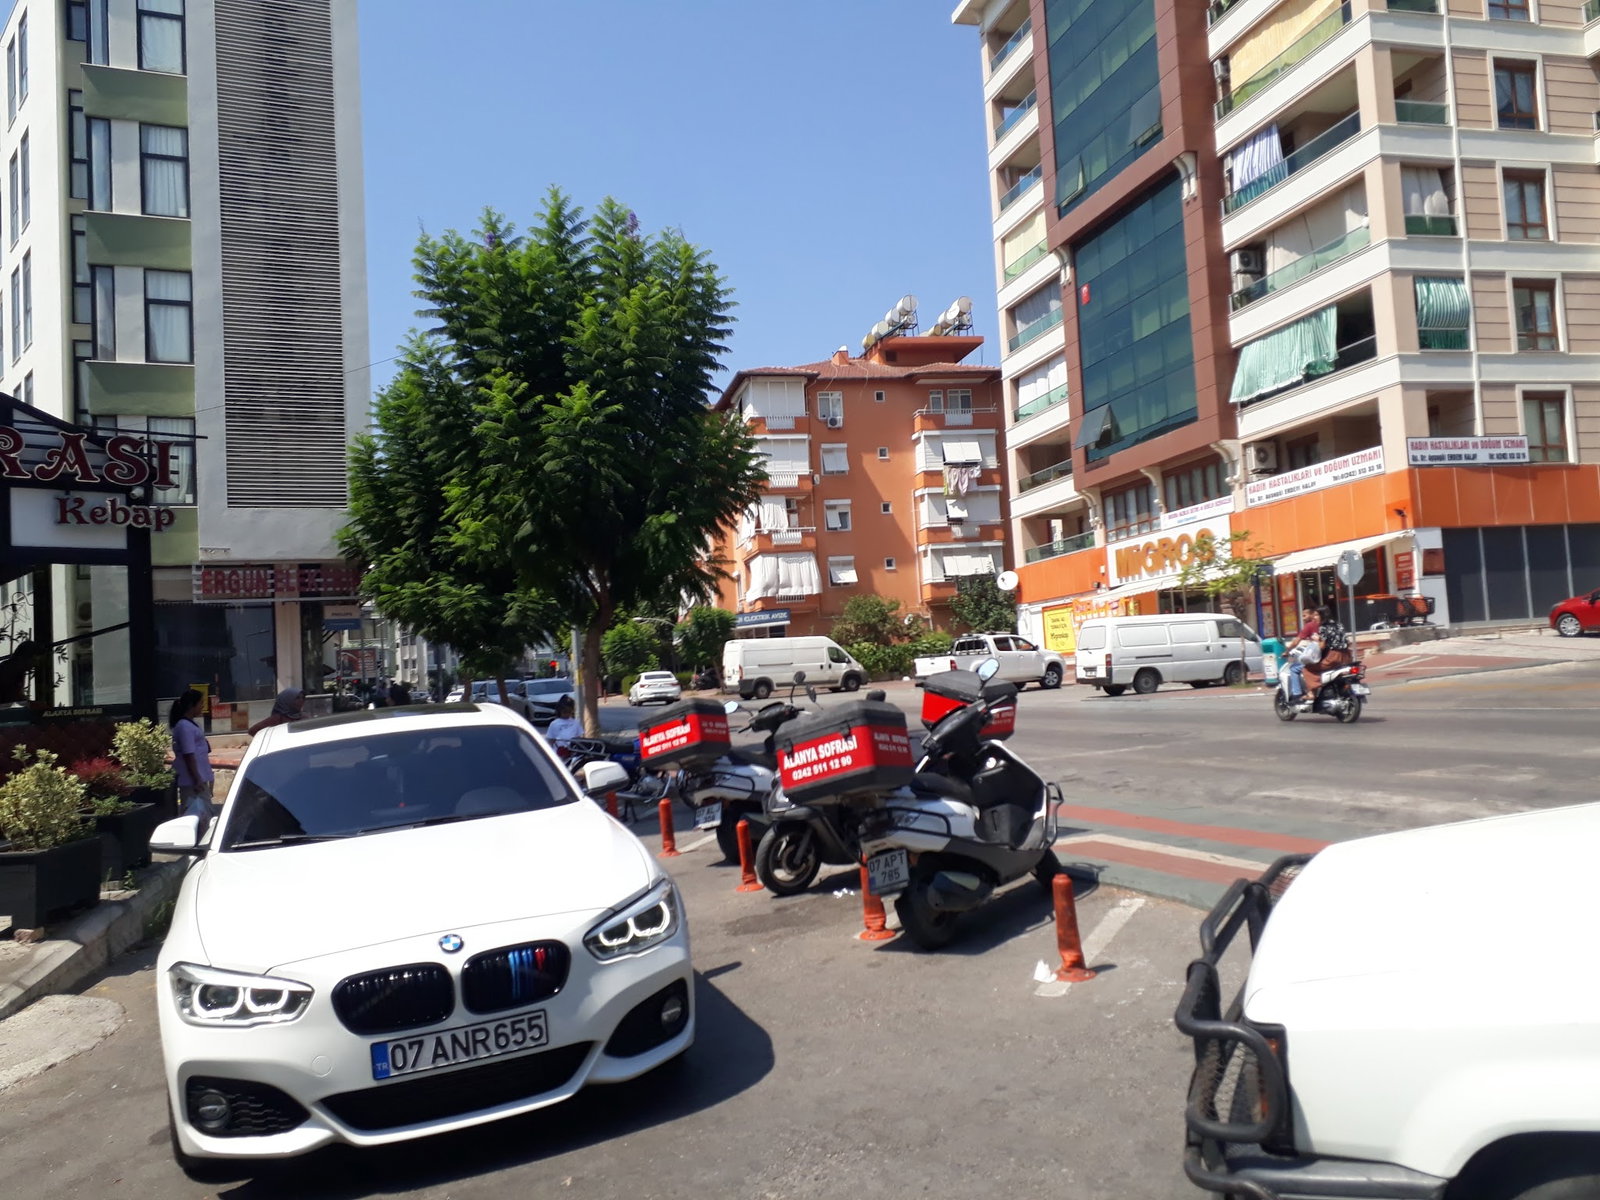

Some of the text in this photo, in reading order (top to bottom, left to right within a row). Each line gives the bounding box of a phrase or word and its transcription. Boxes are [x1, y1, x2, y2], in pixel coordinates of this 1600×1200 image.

[1324, 458, 1350, 474] DOĞUM
[1351, 449, 1381, 466] UZMANI
[55, 498, 176, 532] Kebap
[643, 731, 666, 746] ALANYA
[784, 747, 819, 770] ALANYA
[792, 767, 812, 781] 0242
[829, 758, 840, 770] 12
[840, 755, 852, 767] 90
[869, 851, 905, 873] 07 APT
[881, 868, 900, 881] 785
[390, 1014, 544, 1071] 07 ANR 655
[375, 1062, 389, 1072] TR
